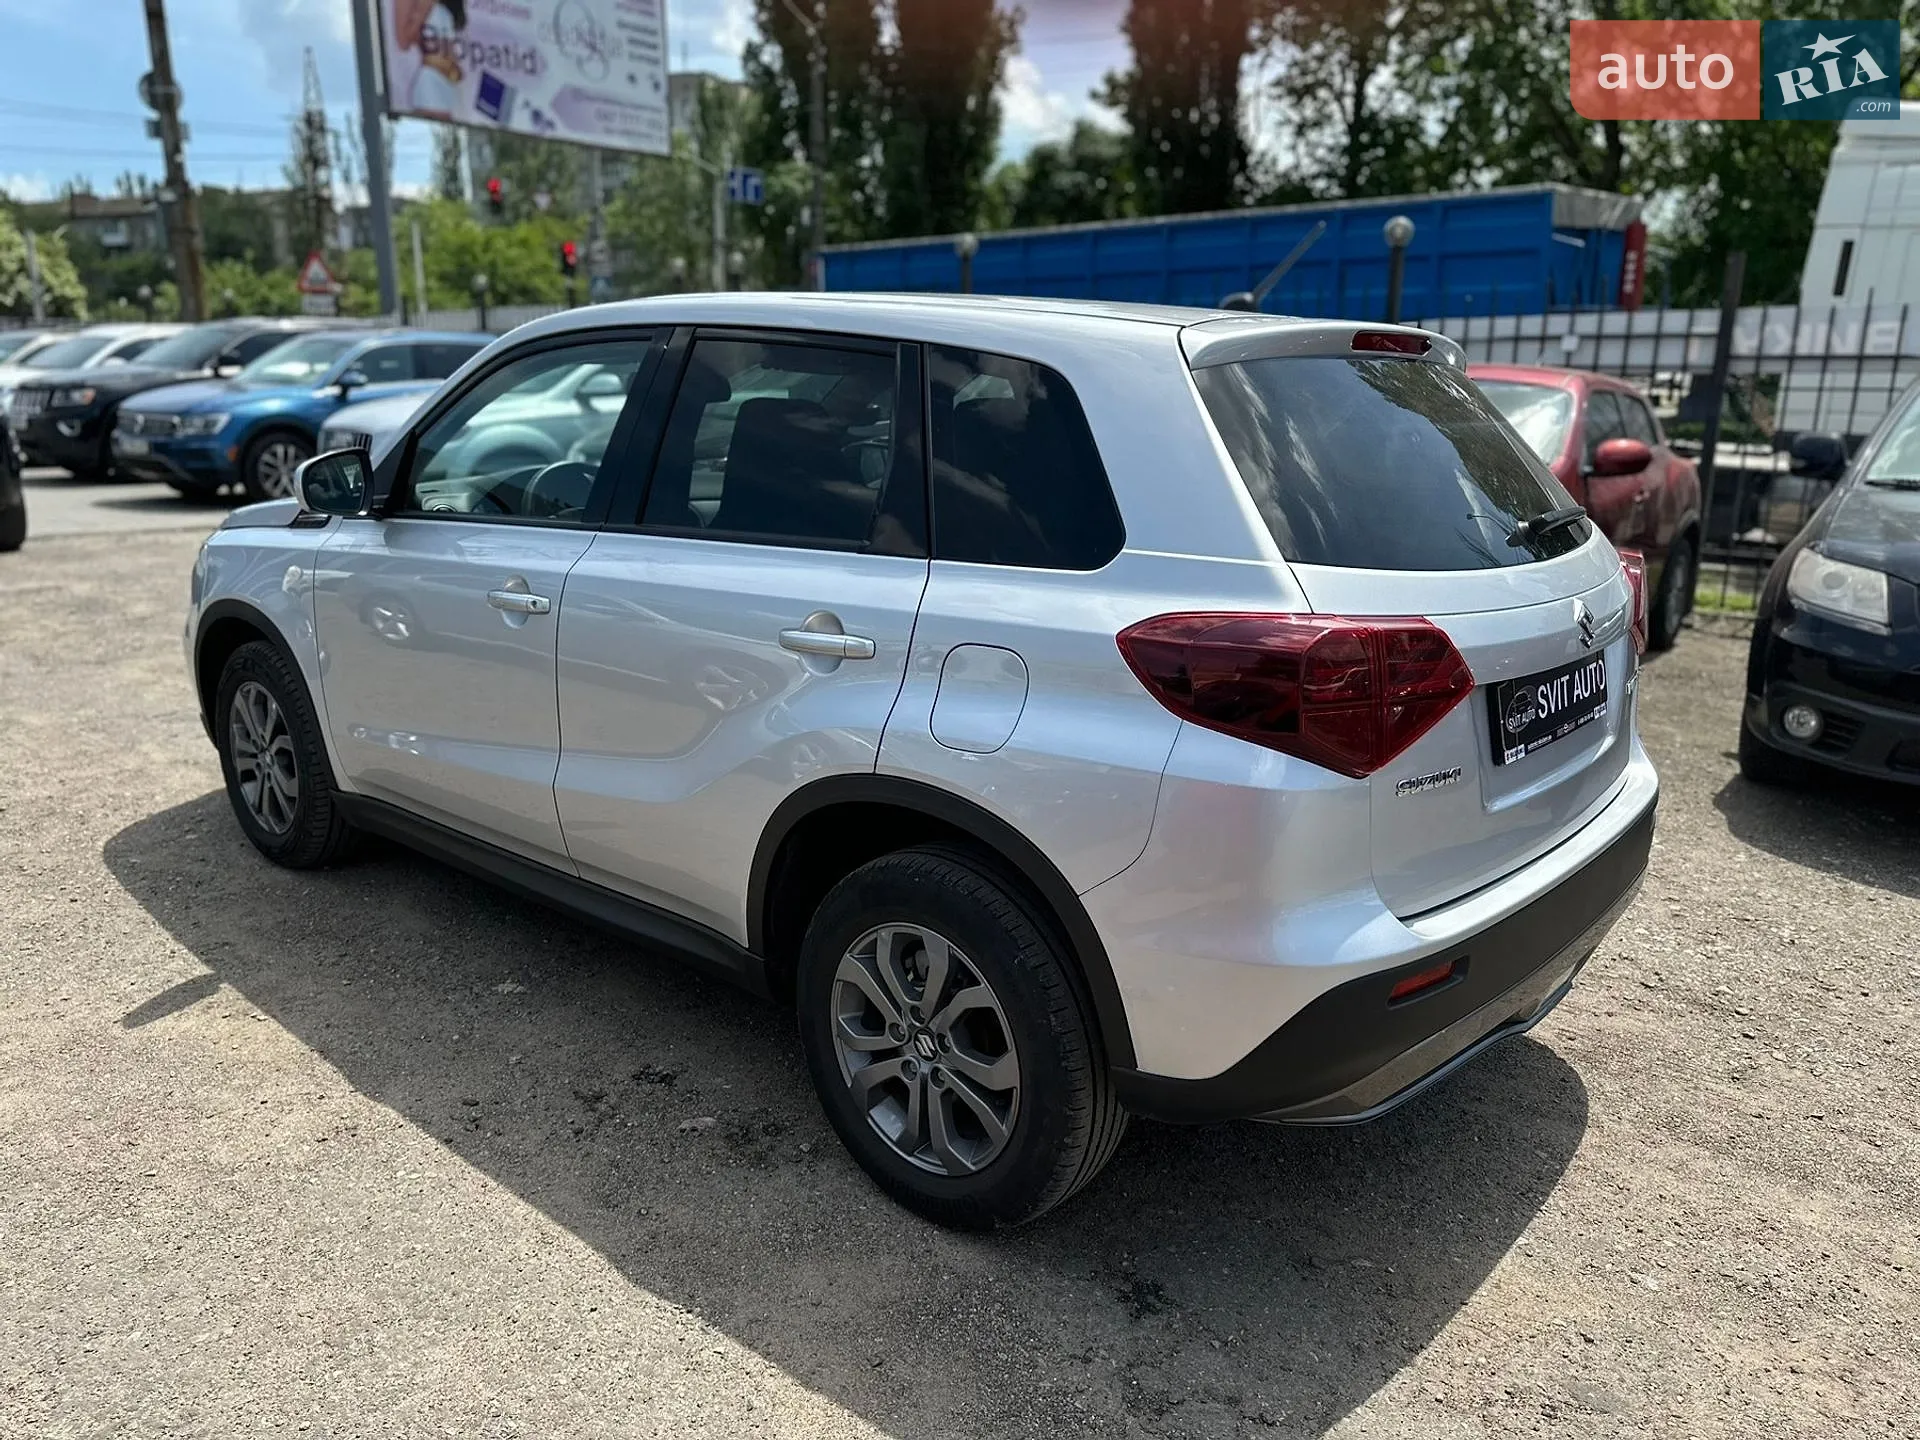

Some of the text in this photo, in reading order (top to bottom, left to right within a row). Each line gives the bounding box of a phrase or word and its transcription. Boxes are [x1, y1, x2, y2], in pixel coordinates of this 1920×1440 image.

[1538, 674, 1570, 719] SVIT
[1573, 659, 1606, 704] AUTO
[1395, 766, 1463, 797] SUZUKI
